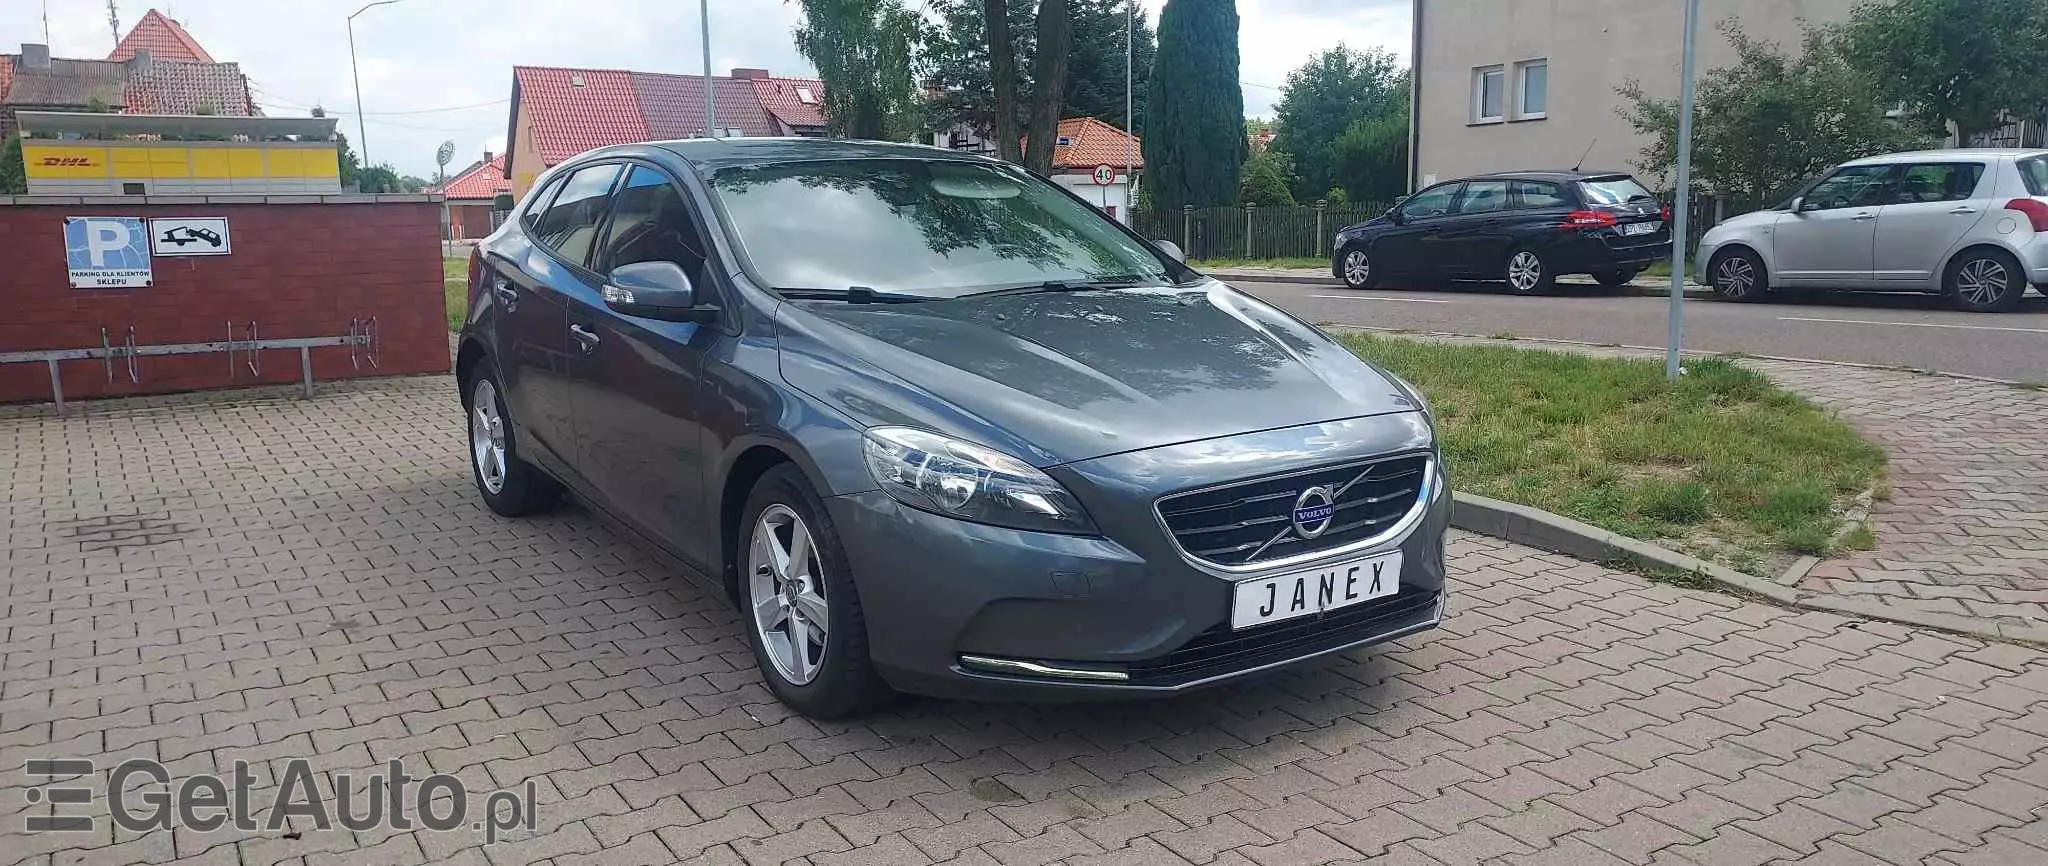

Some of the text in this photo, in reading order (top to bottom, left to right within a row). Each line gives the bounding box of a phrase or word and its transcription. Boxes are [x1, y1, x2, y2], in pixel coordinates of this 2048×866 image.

[43, 157, 91, 167] DHL
[1096, 169, 1112, 181] 40
[86, 221, 131, 267] P
[116, 270, 150, 278] KLIENTÓW
[96, 278, 128, 286] SKLEPU
[1297, 507, 1332, 520] VOLVO
[1259, 560, 1385, 618] JANEX
